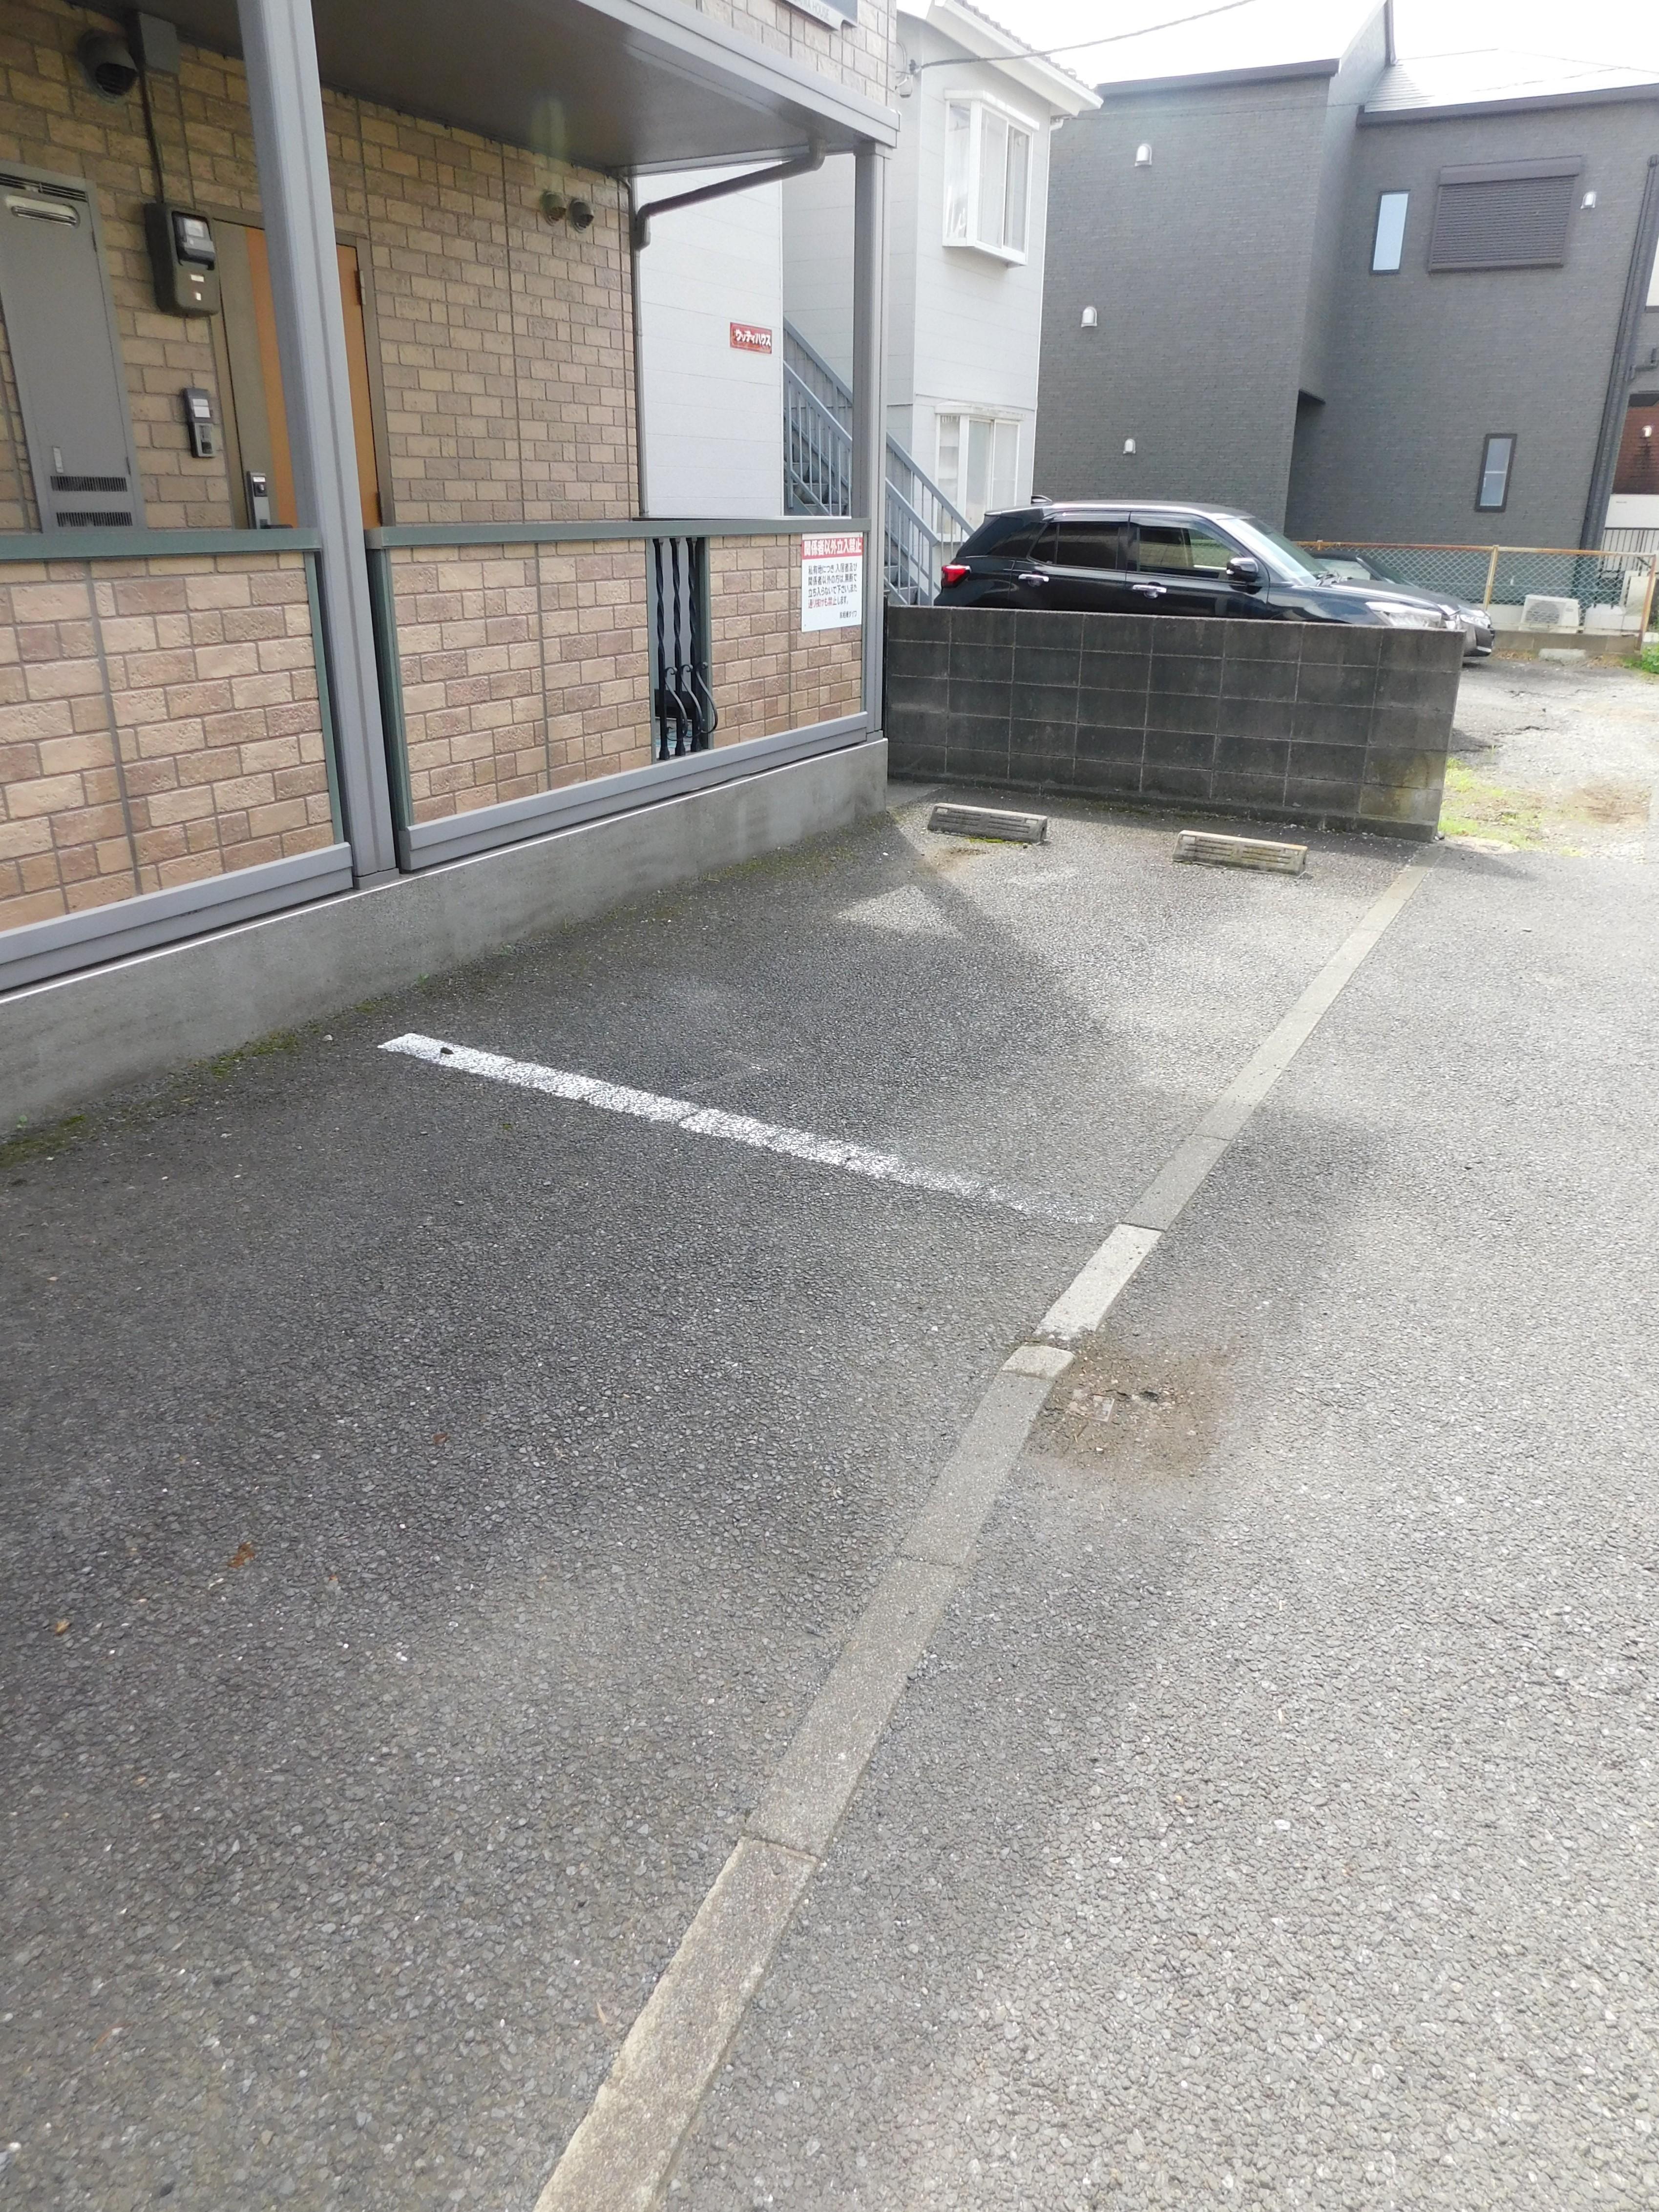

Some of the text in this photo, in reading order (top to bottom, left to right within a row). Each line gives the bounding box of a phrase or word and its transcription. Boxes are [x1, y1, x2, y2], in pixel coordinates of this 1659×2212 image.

[811, 1, 829, 21] HOUSE
[804, 538, 861, 556] 関係者以外立入禁止
